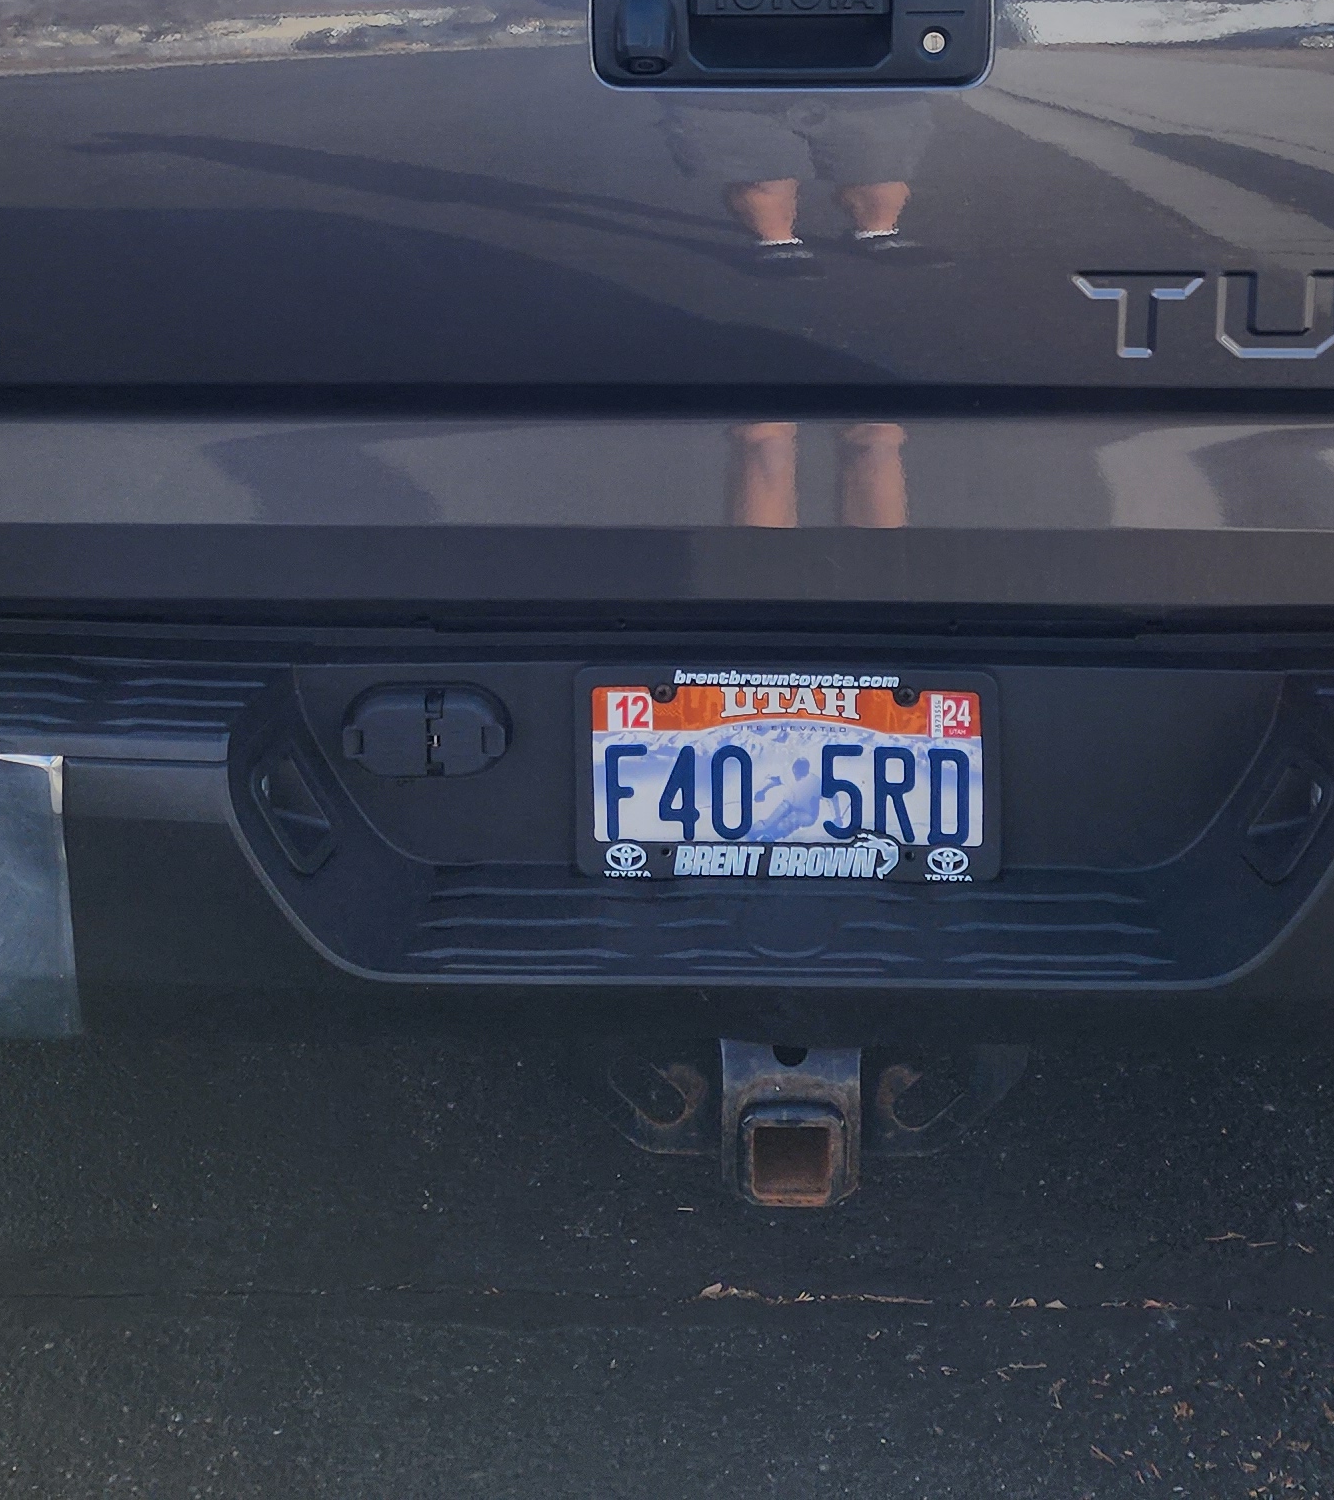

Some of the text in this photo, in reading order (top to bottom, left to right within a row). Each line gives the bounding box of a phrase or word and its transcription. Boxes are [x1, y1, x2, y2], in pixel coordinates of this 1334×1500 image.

[673, 669, 900, 688] brentbrowntoyota.com
[614, 695, 650, 729] 12
[720, 686, 861, 720] UTAH
[943, 699, 972, 728] 24
[603, 870, 652, 878] TOYOTA
[673, 845, 878, 878] BRENT BROWN
[924, 874, 973, 882] TOYOTA
